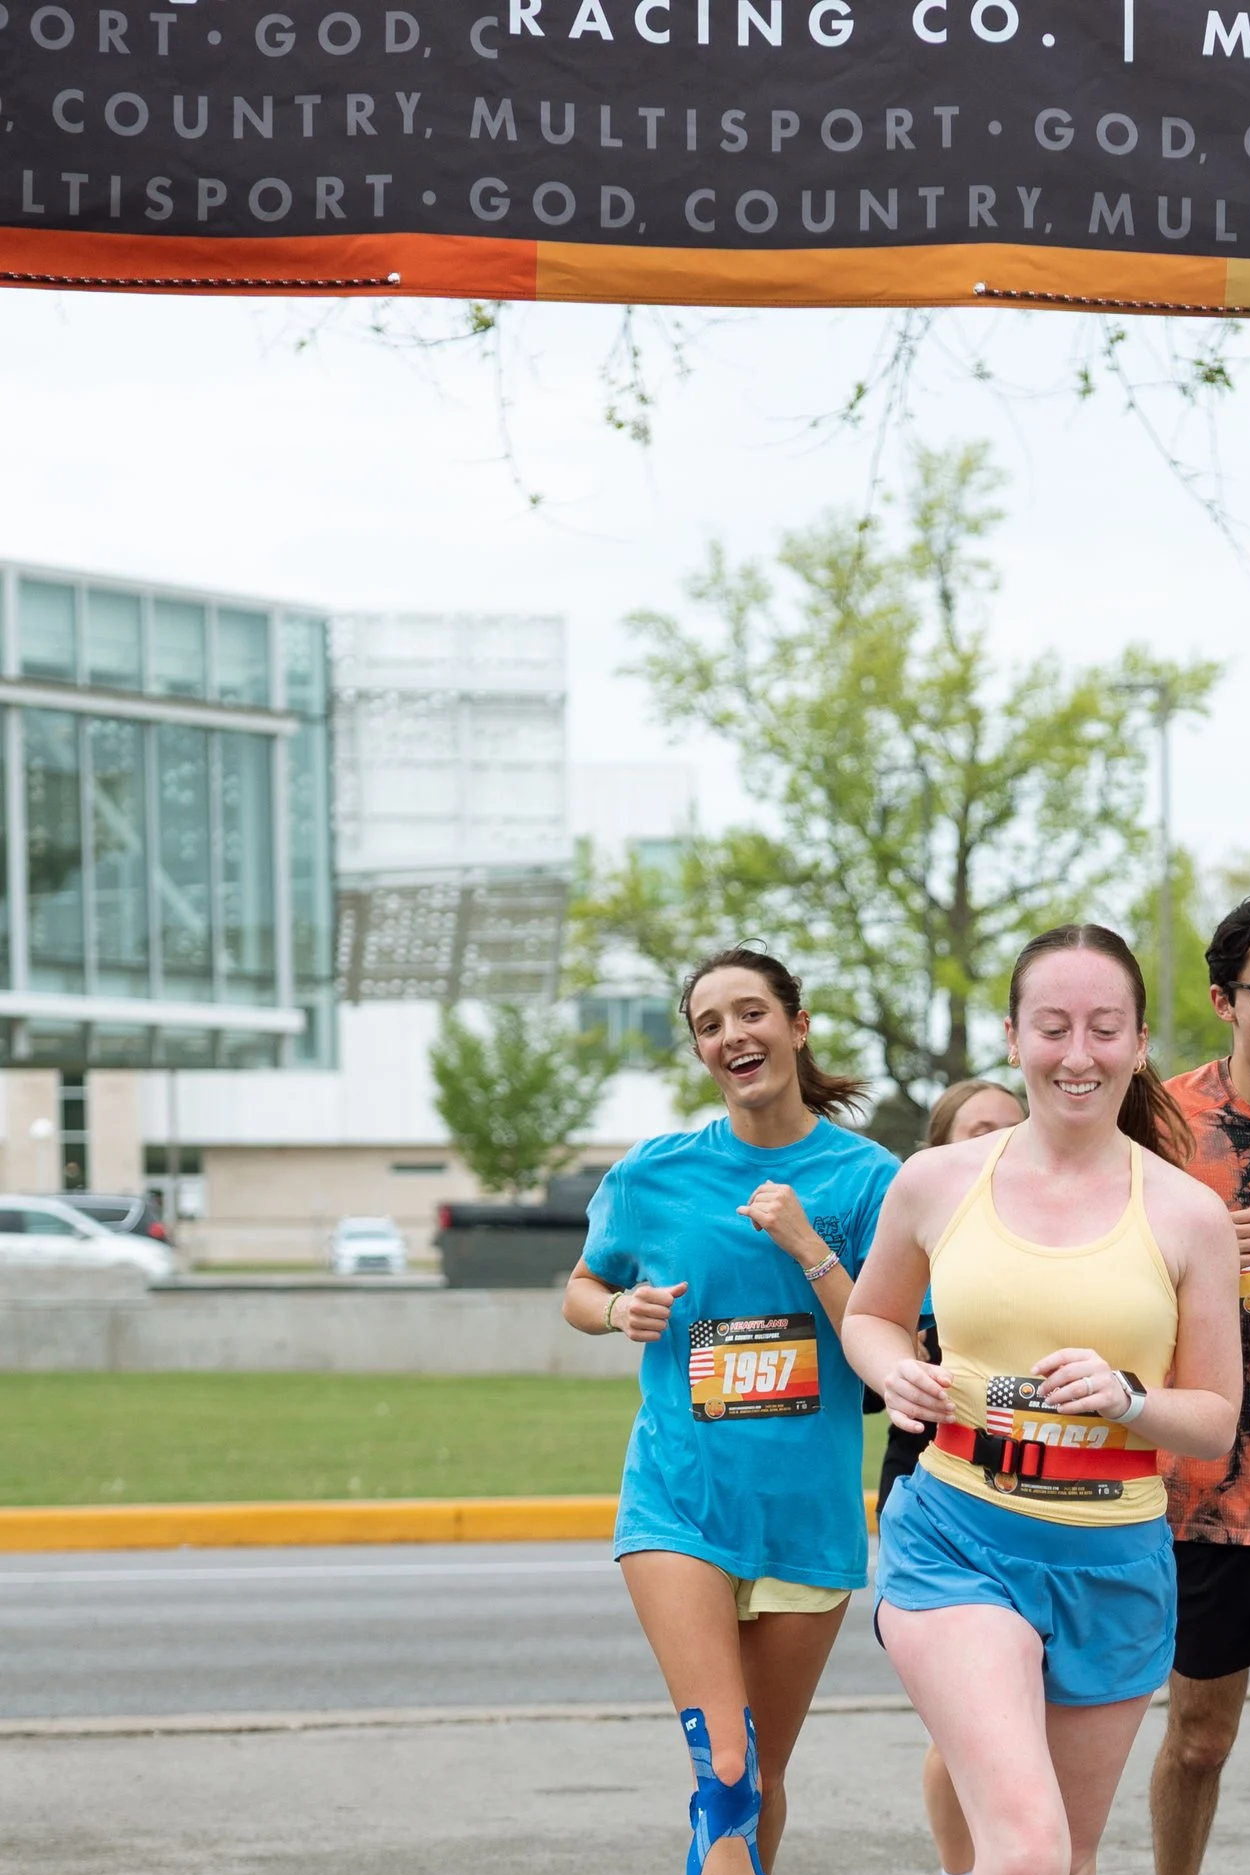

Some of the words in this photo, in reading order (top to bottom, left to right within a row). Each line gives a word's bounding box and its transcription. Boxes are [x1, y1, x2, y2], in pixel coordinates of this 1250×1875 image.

[255, 12, 431, 60] GOD,
[508, 0, 855, 49] RACING
[912, 0, 1056, 49] CO.
[52, 88, 432, 141] COUNTRY,
[470, 96, 960, 154] MULTISPORT
[1034, 107, 1207, 165] GOD,
[22, 169, 393, 221] LTISPORT
[470, 176, 646, 233] GOD,
[685, 184, 1053, 235] COUNTRY,
[730, 1319, 789, 1330] HEARTLAND
[722, 1349, 797, 1394] 1957
